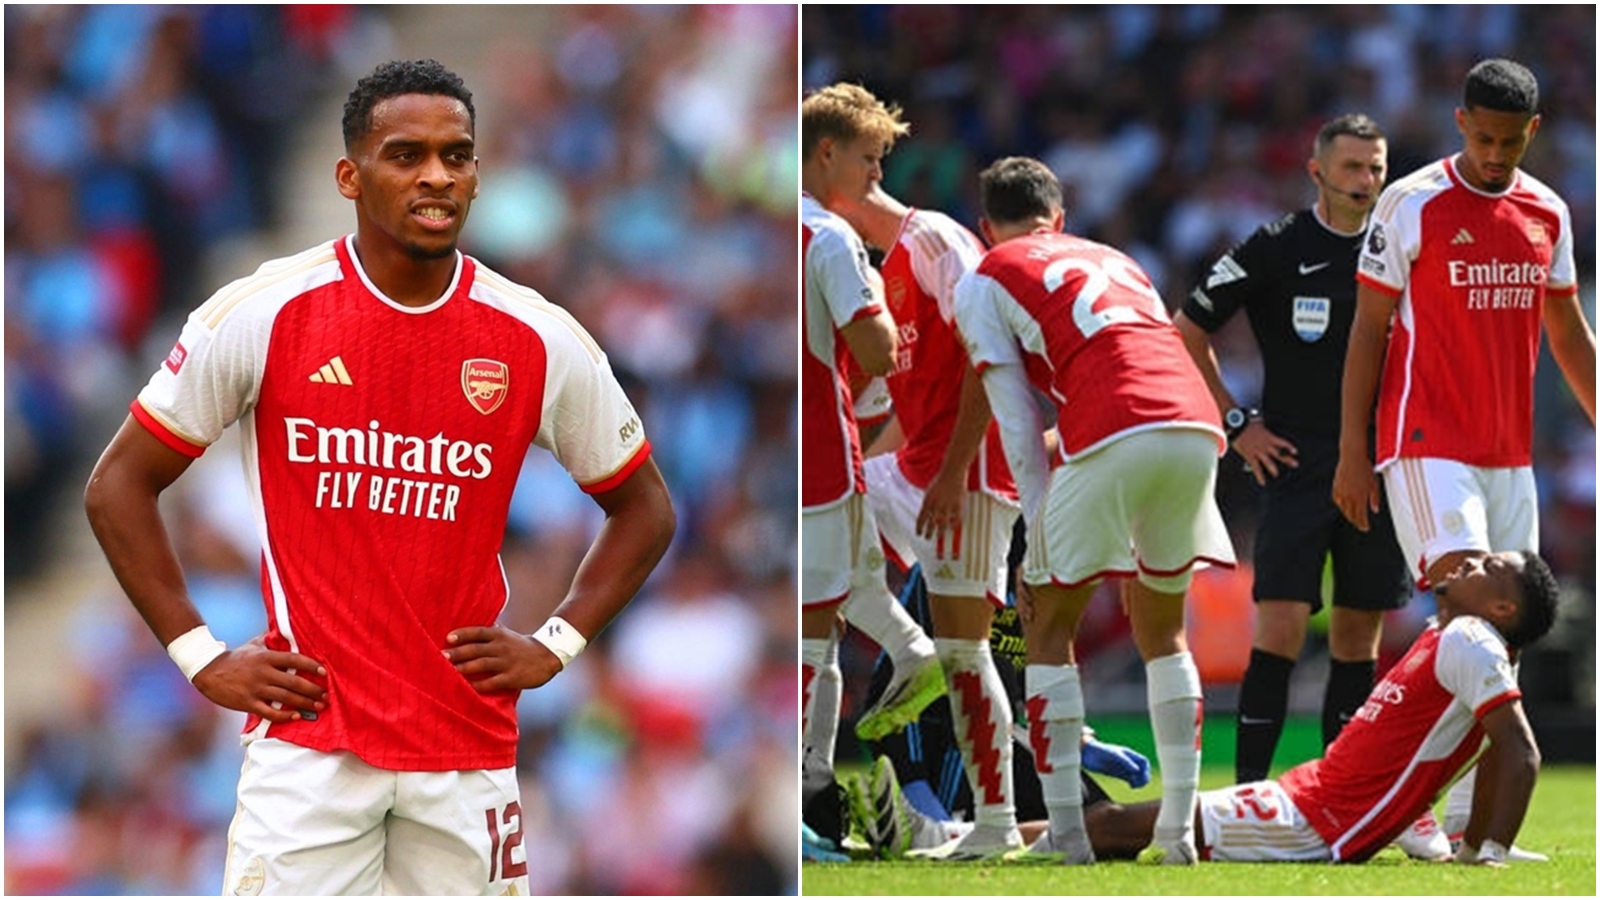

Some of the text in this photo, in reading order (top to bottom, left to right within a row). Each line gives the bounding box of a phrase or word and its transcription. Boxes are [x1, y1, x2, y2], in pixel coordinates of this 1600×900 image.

[1448, 257, 1547, 286] Emirates
[1297, 300, 1326, 312] FIFA
[1468, 287, 1535, 310] FLY BETTER
[469, 367, 503, 380] Arsenal
[283, 416, 493, 480] Emirates
[315, 471, 461, 522] FLY BETTER
[485, 801, 528, 883] 12
